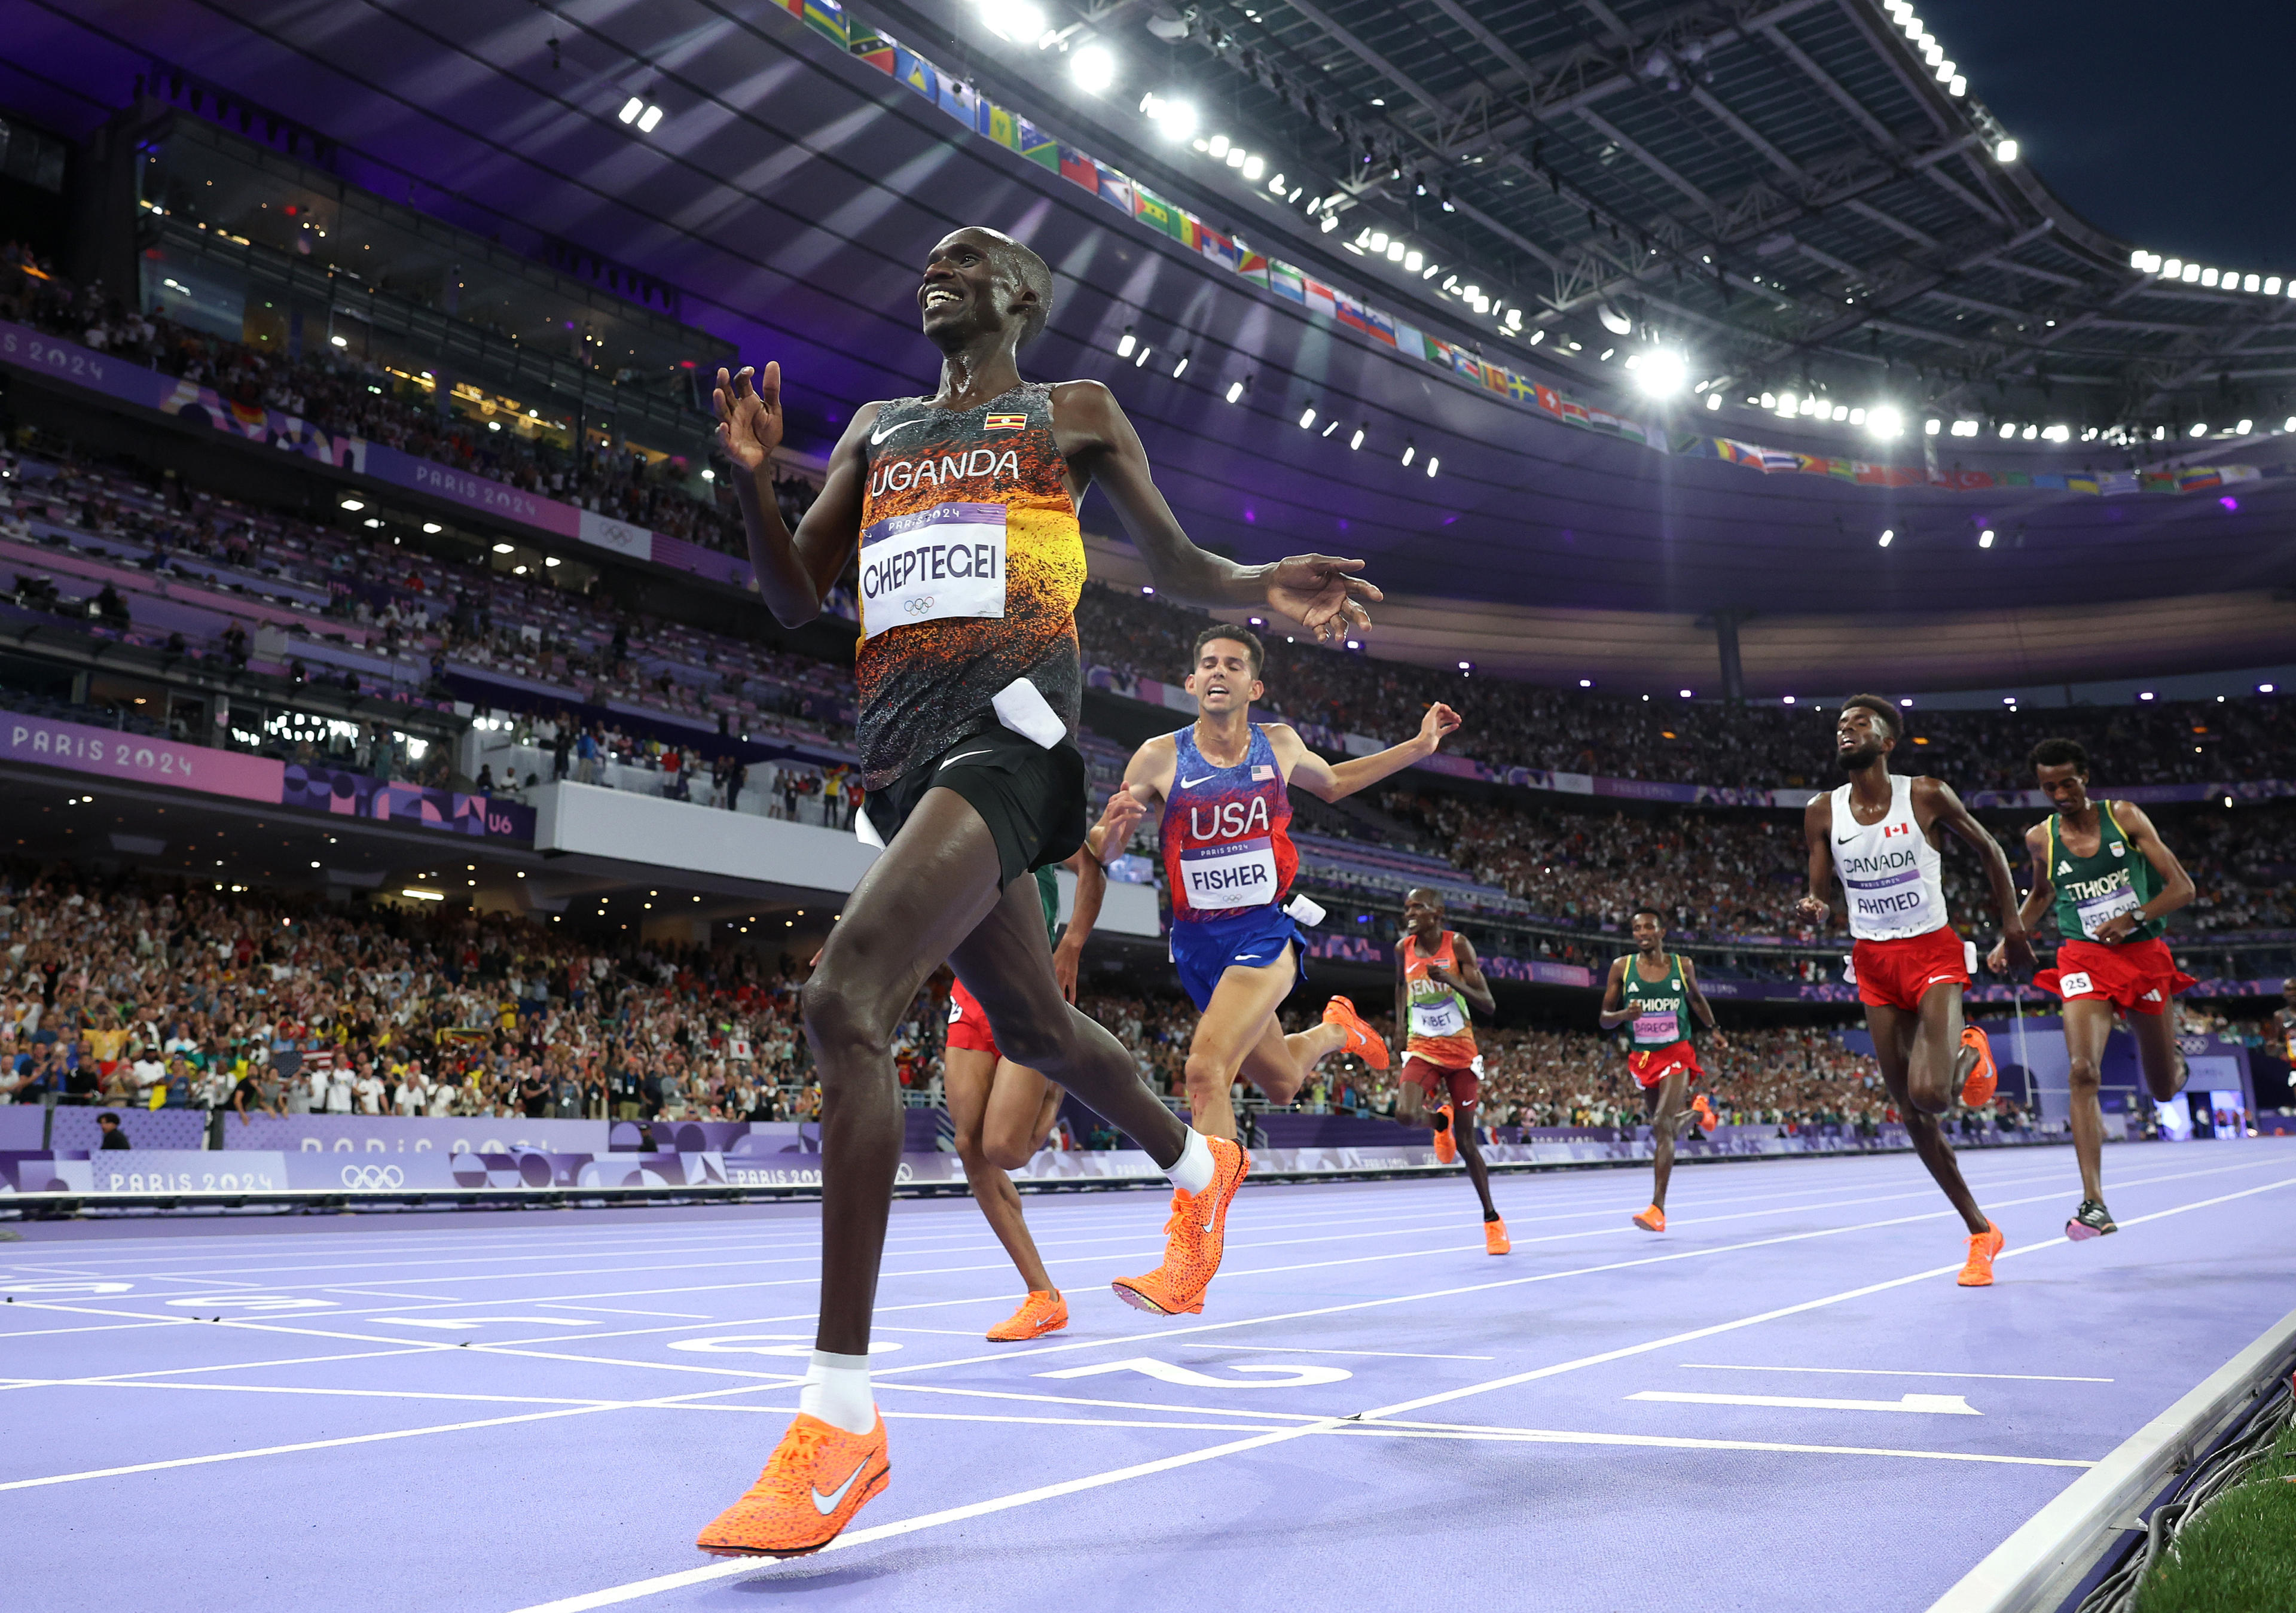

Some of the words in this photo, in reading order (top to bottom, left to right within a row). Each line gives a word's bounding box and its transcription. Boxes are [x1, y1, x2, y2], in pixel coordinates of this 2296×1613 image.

[30, 341, 103, 380] 2024
[872, 449, 1019, 496] UGANDA
[416, 465, 476, 499] PARIS
[484, 487, 536, 516] 2024
[888, 516, 923, 531] PARIS
[863, 544, 996, 599] CHEPTEGEI
[12, 726, 103, 761] PARIS
[116, 745, 192, 776] 2024
[488, 813, 512, 834] U6
[1190, 795, 1269, 840] USA
[1201, 847, 1225, 856] PARIS
[1226, 844, 1248, 853] 2024
[1843, 850, 1916, 873] CANADA
[1192, 864, 1268, 890] FISHER
[1858, 892, 1920, 914] AHMED
[2066, 978, 2087, 990] 25
[1629, 998, 1681, 1012] HIOPIA
[110, 1173, 193, 1191] PARIS
[202, 1173, 273, 1191] 2024
[737, 1169, 787, 1184] PARIS
[790, 1169, 823, 1184] 202
[1028, 1356, 1354, 1389] 2
[1622, 1391, 1984, 1416] 1
